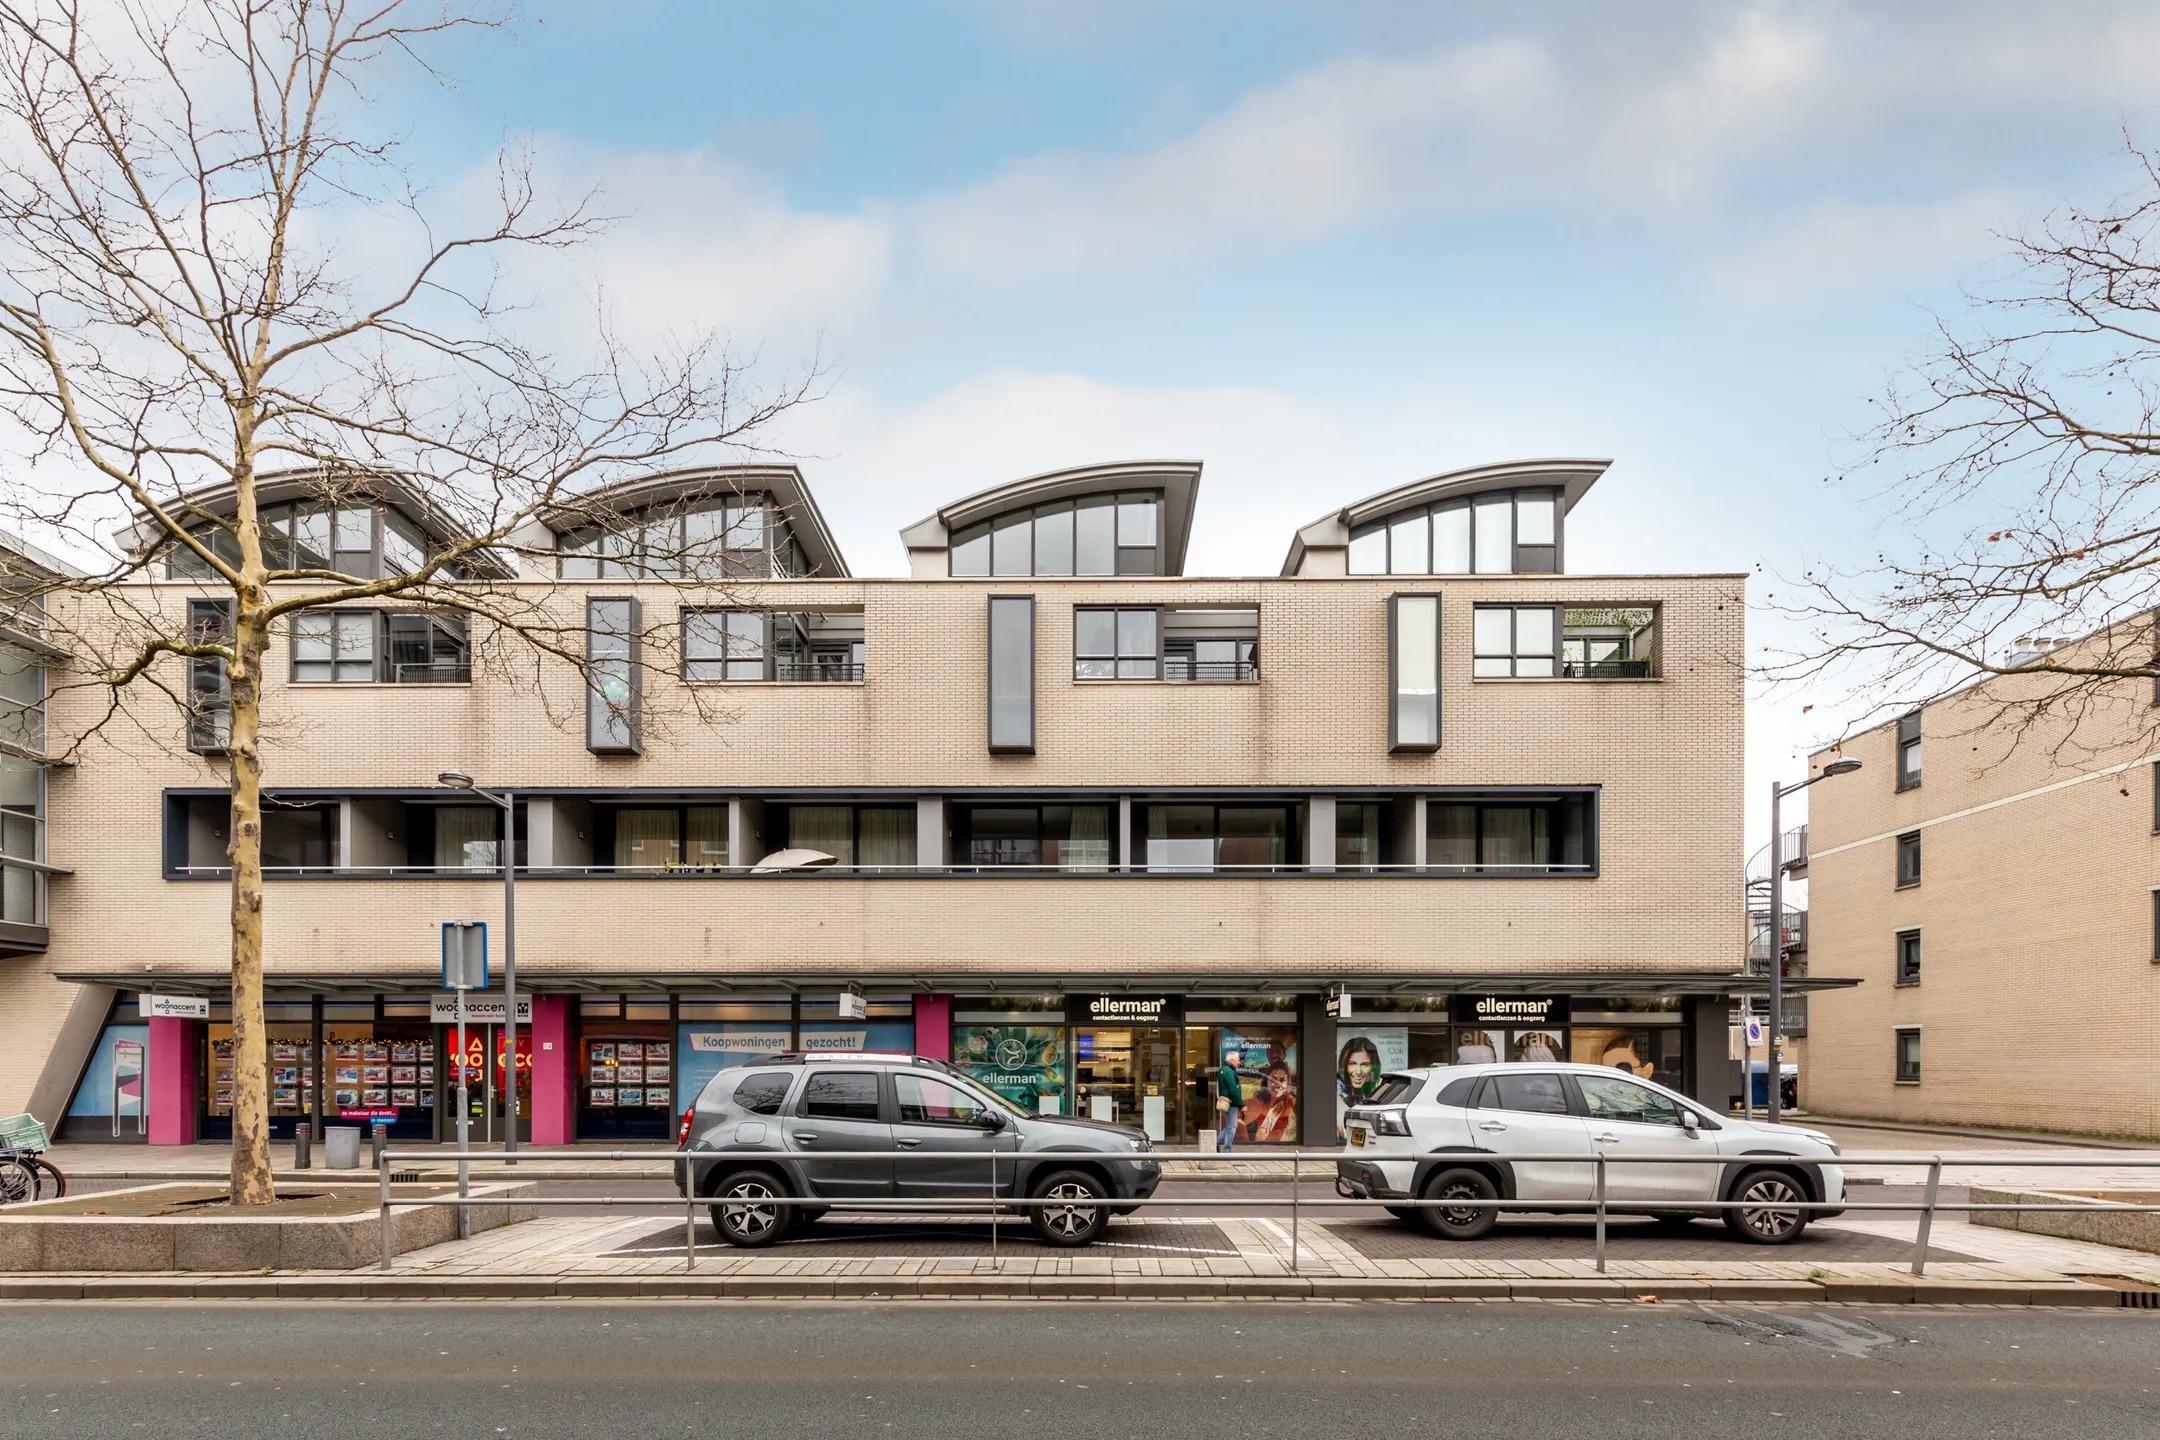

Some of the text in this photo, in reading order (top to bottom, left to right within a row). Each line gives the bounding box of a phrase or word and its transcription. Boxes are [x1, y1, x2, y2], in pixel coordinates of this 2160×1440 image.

[154, 1003, 197, 1011] woonaccent
[1522, 1015, 1546, 1023] oogzorg
[703, 1036, 856, 1049] Koopwoningen gezocht!
[1387, 1046, 1405, 1055] Ook
[1390, 1057, 1405, 1065] iets
